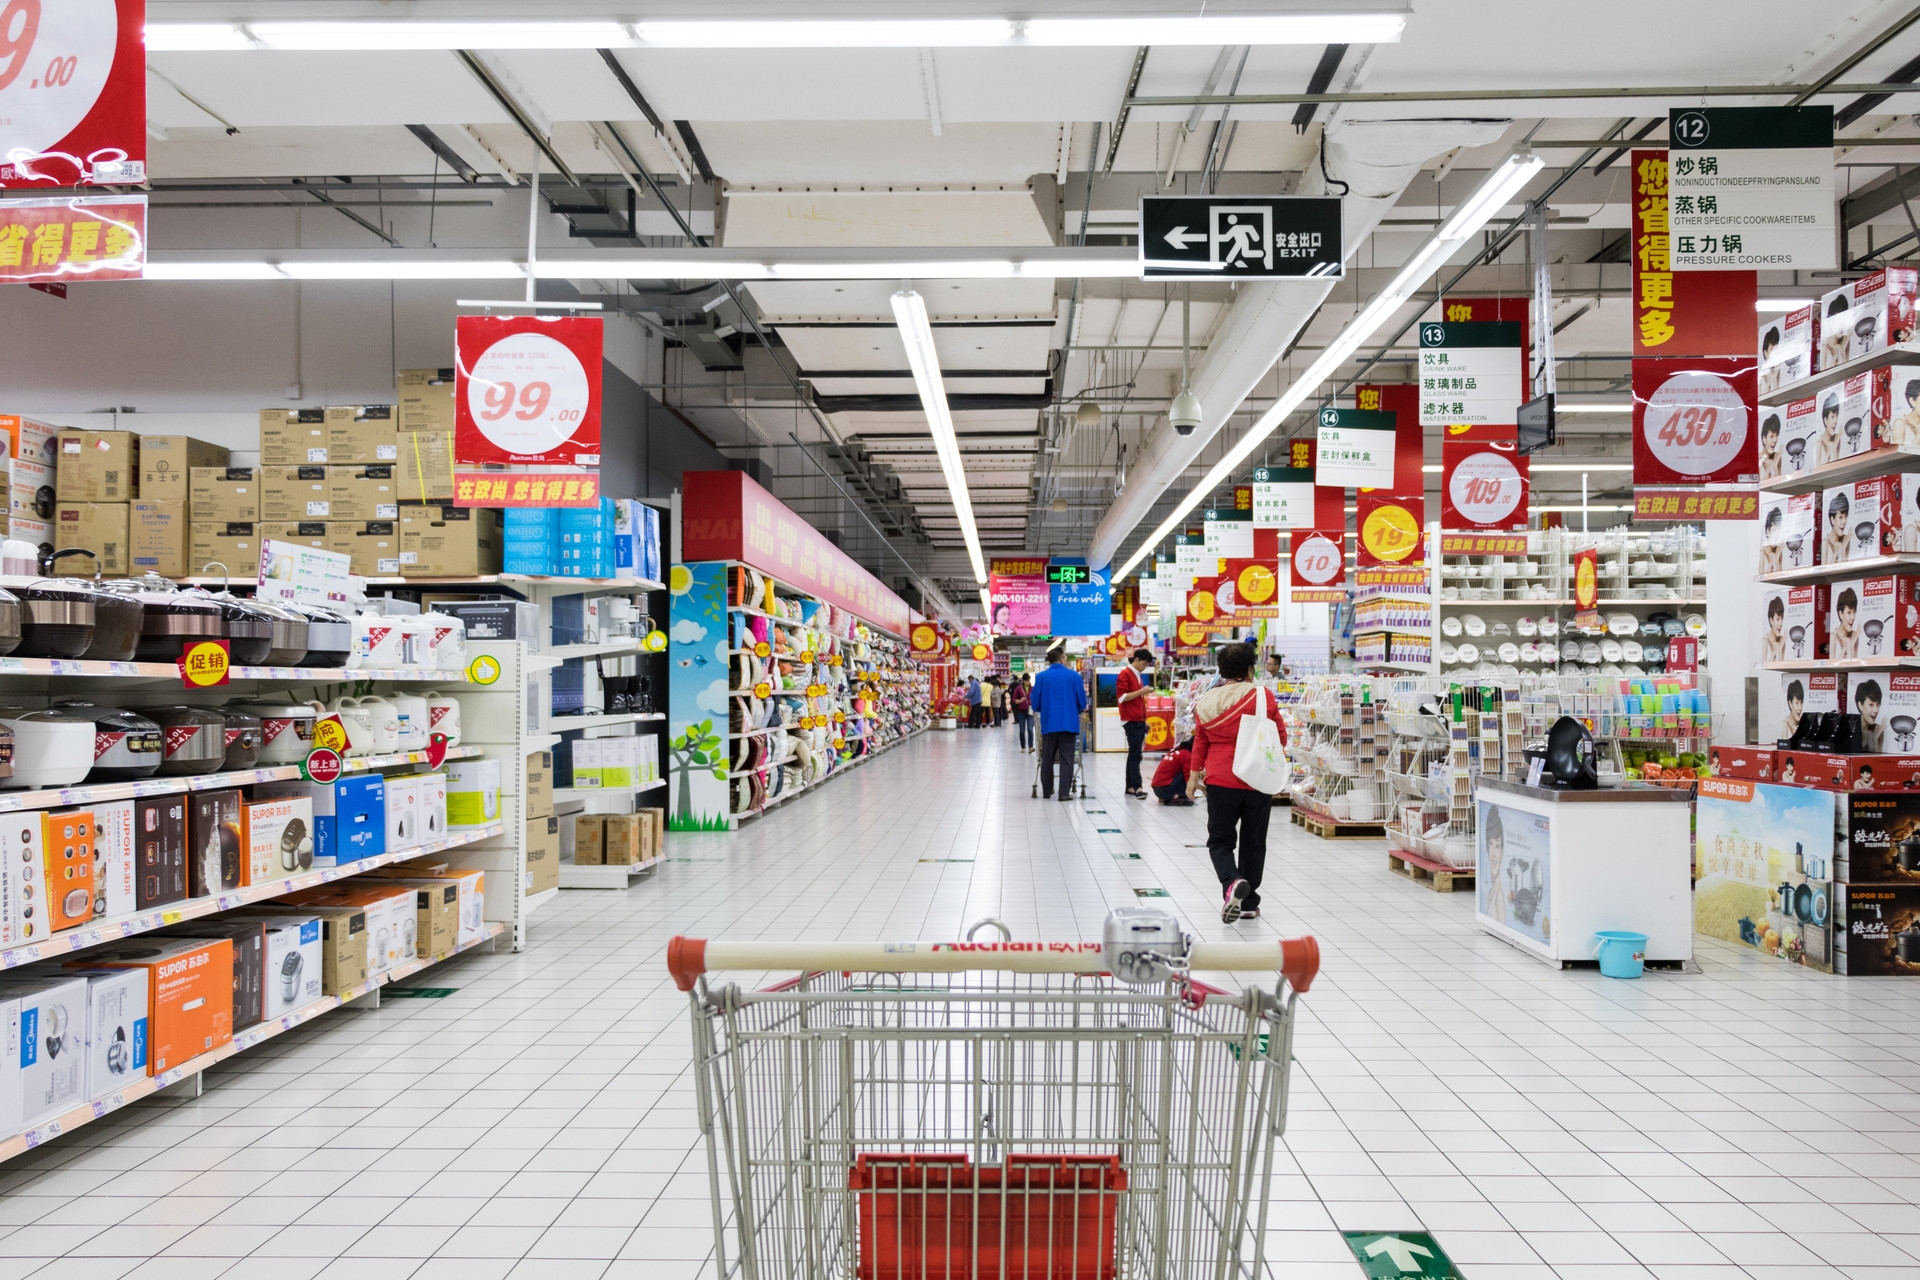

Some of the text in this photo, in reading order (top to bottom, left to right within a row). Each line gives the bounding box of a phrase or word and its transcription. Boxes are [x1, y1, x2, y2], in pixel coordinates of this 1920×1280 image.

[1678, 119, 1704, 138] 12
[1675, 156, 1718, 176] 炒锅
[1675, 176, 1820, 187] NONINDUCTIONDEEPFRYINGPANSLAND
[1675, 195, 1718, 215] 蒸锅
[1674, 214, 1816, 226] OTHER SPECIFIC COOKWAREITEMS
[1275, 232, 1322, 249] 安全出口
[1677, 234, 1742, 254] 压力锅
[1280, 248, 1317, 258] EXIT
[1676, 254, 1792, 265] PRESSURE COOKERS
[1425, 328, 1442, 342] 13
[1423, 353, 1450, 365] 饮具
[1423, 377, 1477, 390] 玻璃制品
[480, 381, 580, 421] 99.00
[1423, 402, 1464, 415] 滤水器
[1323, 413, 1336, 424] 14
[1658, 407, 1731, 447] 430.00
[1321, 432, 1340, 440] 饮具
[1320, 450, 1371, 461] 密封保鲜盒
[1257, 471, 1268, 480] 15
[458, 480, 596, 501] 在欧尚 您省得更多
[1464, 477, 1512, 505] 109.00
[1638, 497, 1756, 514] 在欧尚 您省得更多
[1207, 511, 1216, 519] 16
[991, 594, 1049, 603] 400-101-2211
[1057, 592, 1104, 605] Free wifi
[191, 652, 224, 670] 促销
[189, 668, 224, 676] promotion
[1892, 676, 1910, 685] ASD
[265, 720, 279, 734] 4.0L
[166, 729, 184, 744] 4.0L
[172, 732, 192, 749] 3-4人
[310, 760, 338, 769] 新上市
[1703, 780, 1749, 797] SUPOR 苏泊尔
[252, 808, 275, 821] SUPOR
[123, 809, 131, 857] SUPOR
[158, 952, 209, 980] SUPOR 苏泊尔
